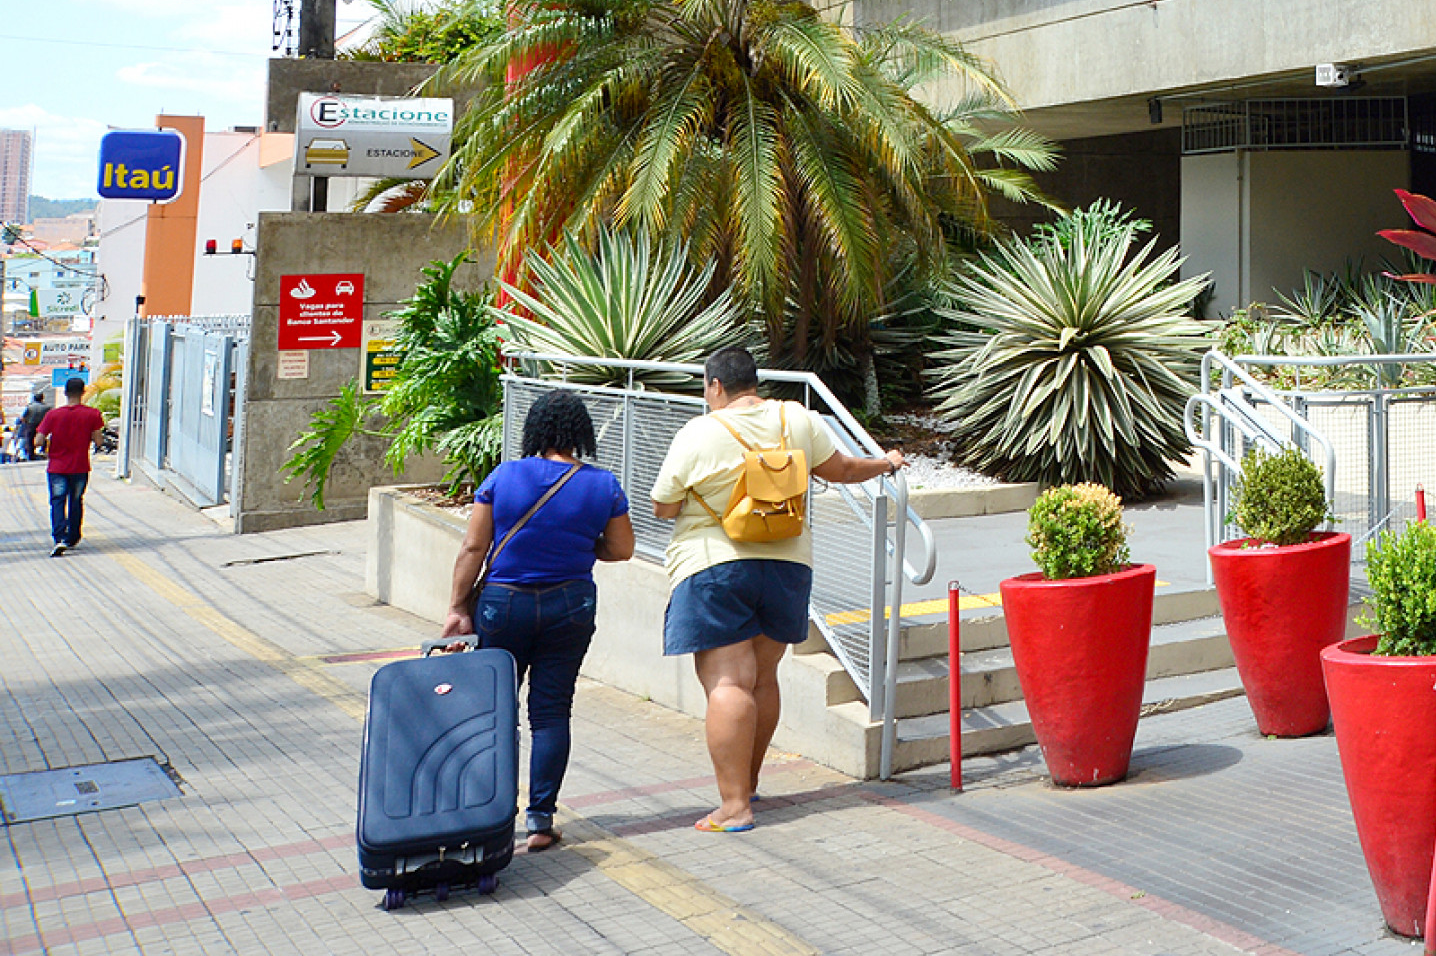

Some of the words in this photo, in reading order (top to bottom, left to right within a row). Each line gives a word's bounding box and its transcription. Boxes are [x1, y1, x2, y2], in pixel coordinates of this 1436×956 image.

[318, 101, 449, 123] Estacione
[366, 149, 425, 158] ESTACIONE
[103, 162, 175, 190] Itaú
